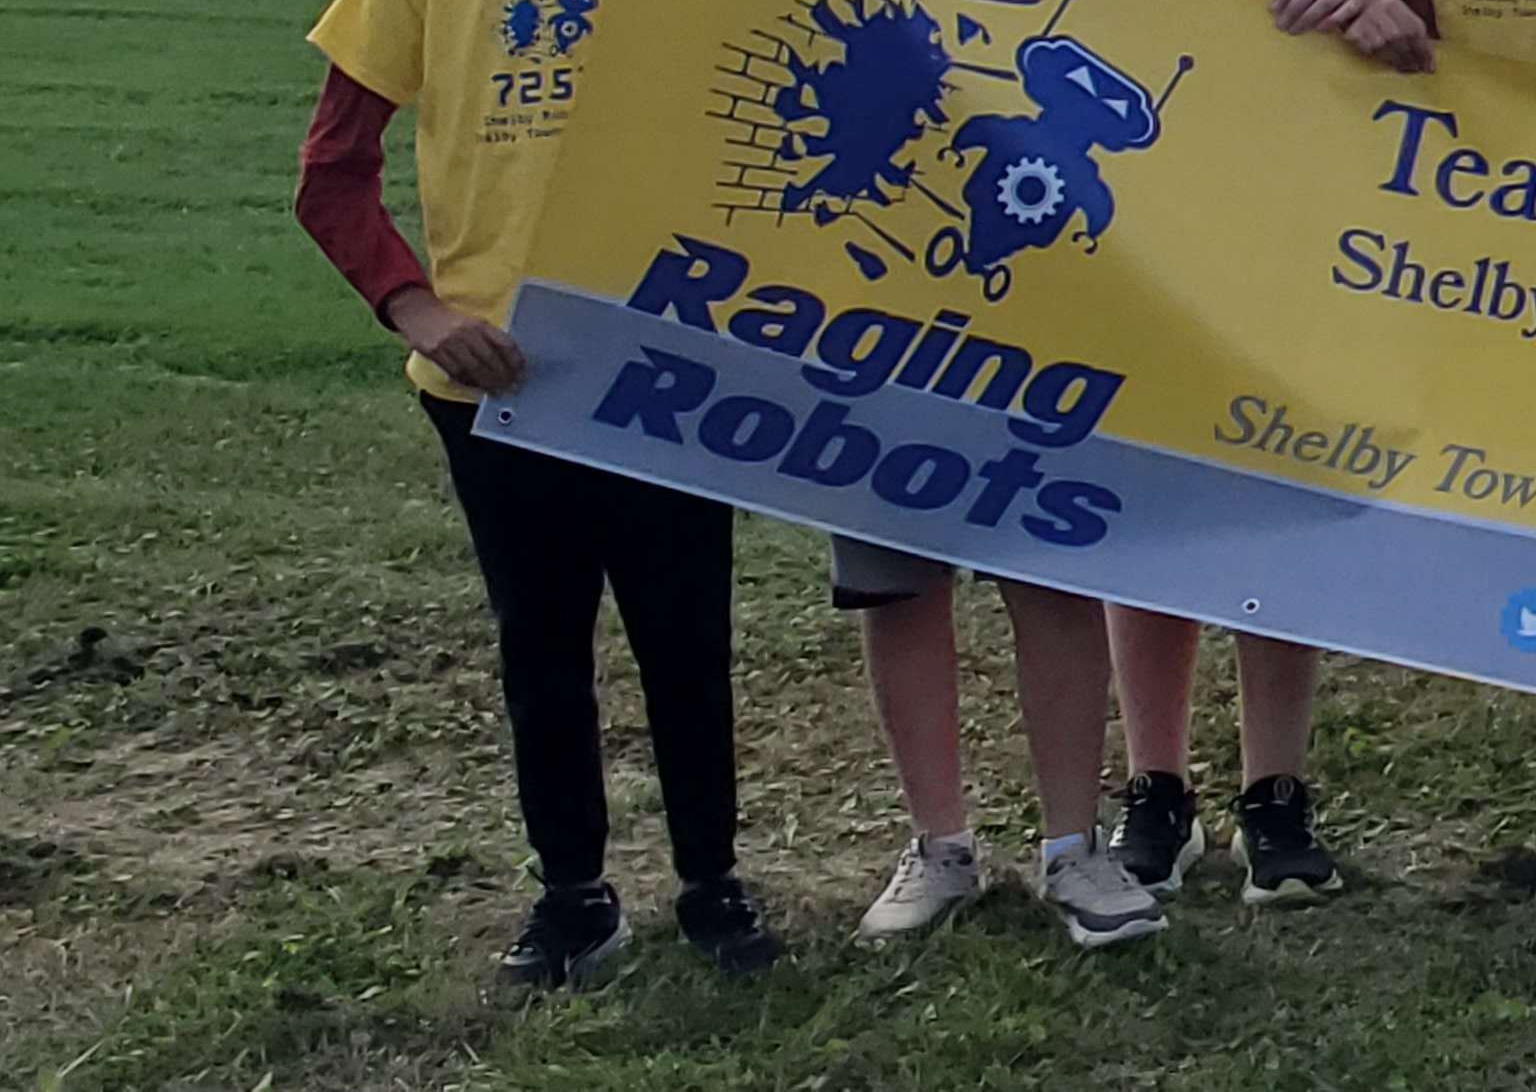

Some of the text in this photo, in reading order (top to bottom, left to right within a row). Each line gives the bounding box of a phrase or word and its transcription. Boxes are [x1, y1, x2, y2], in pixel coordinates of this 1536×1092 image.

[491, 66, 584, 107] 725
[626, 232, 1127, 448] Raging
[592, 345, 1123, 547] Robots
[1213, 394, 1418, 490] Shelby
